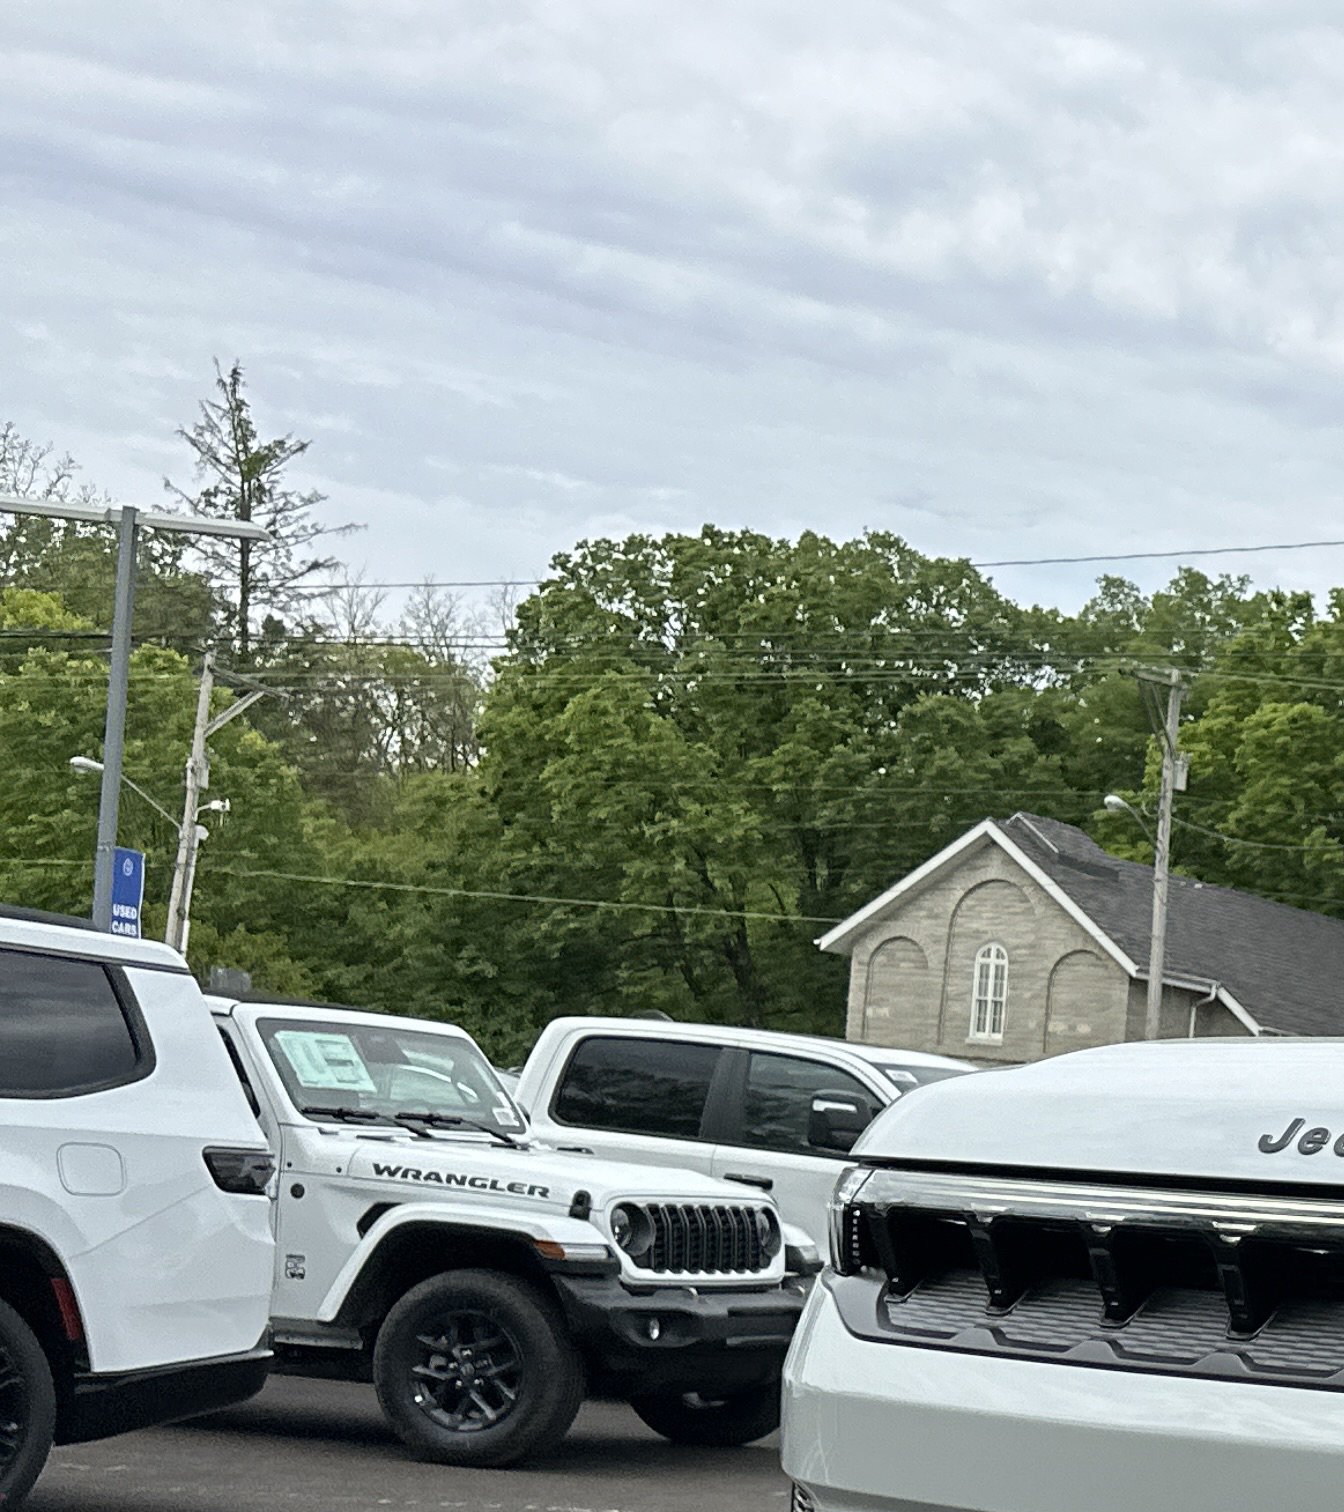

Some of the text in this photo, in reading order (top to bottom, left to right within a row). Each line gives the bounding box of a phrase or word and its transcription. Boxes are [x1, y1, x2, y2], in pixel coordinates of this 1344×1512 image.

[112, 904, 137, 919] USED
[112, 921, 137, 935] CARS
[372, 1163, 550, 1199] WRANGLER
